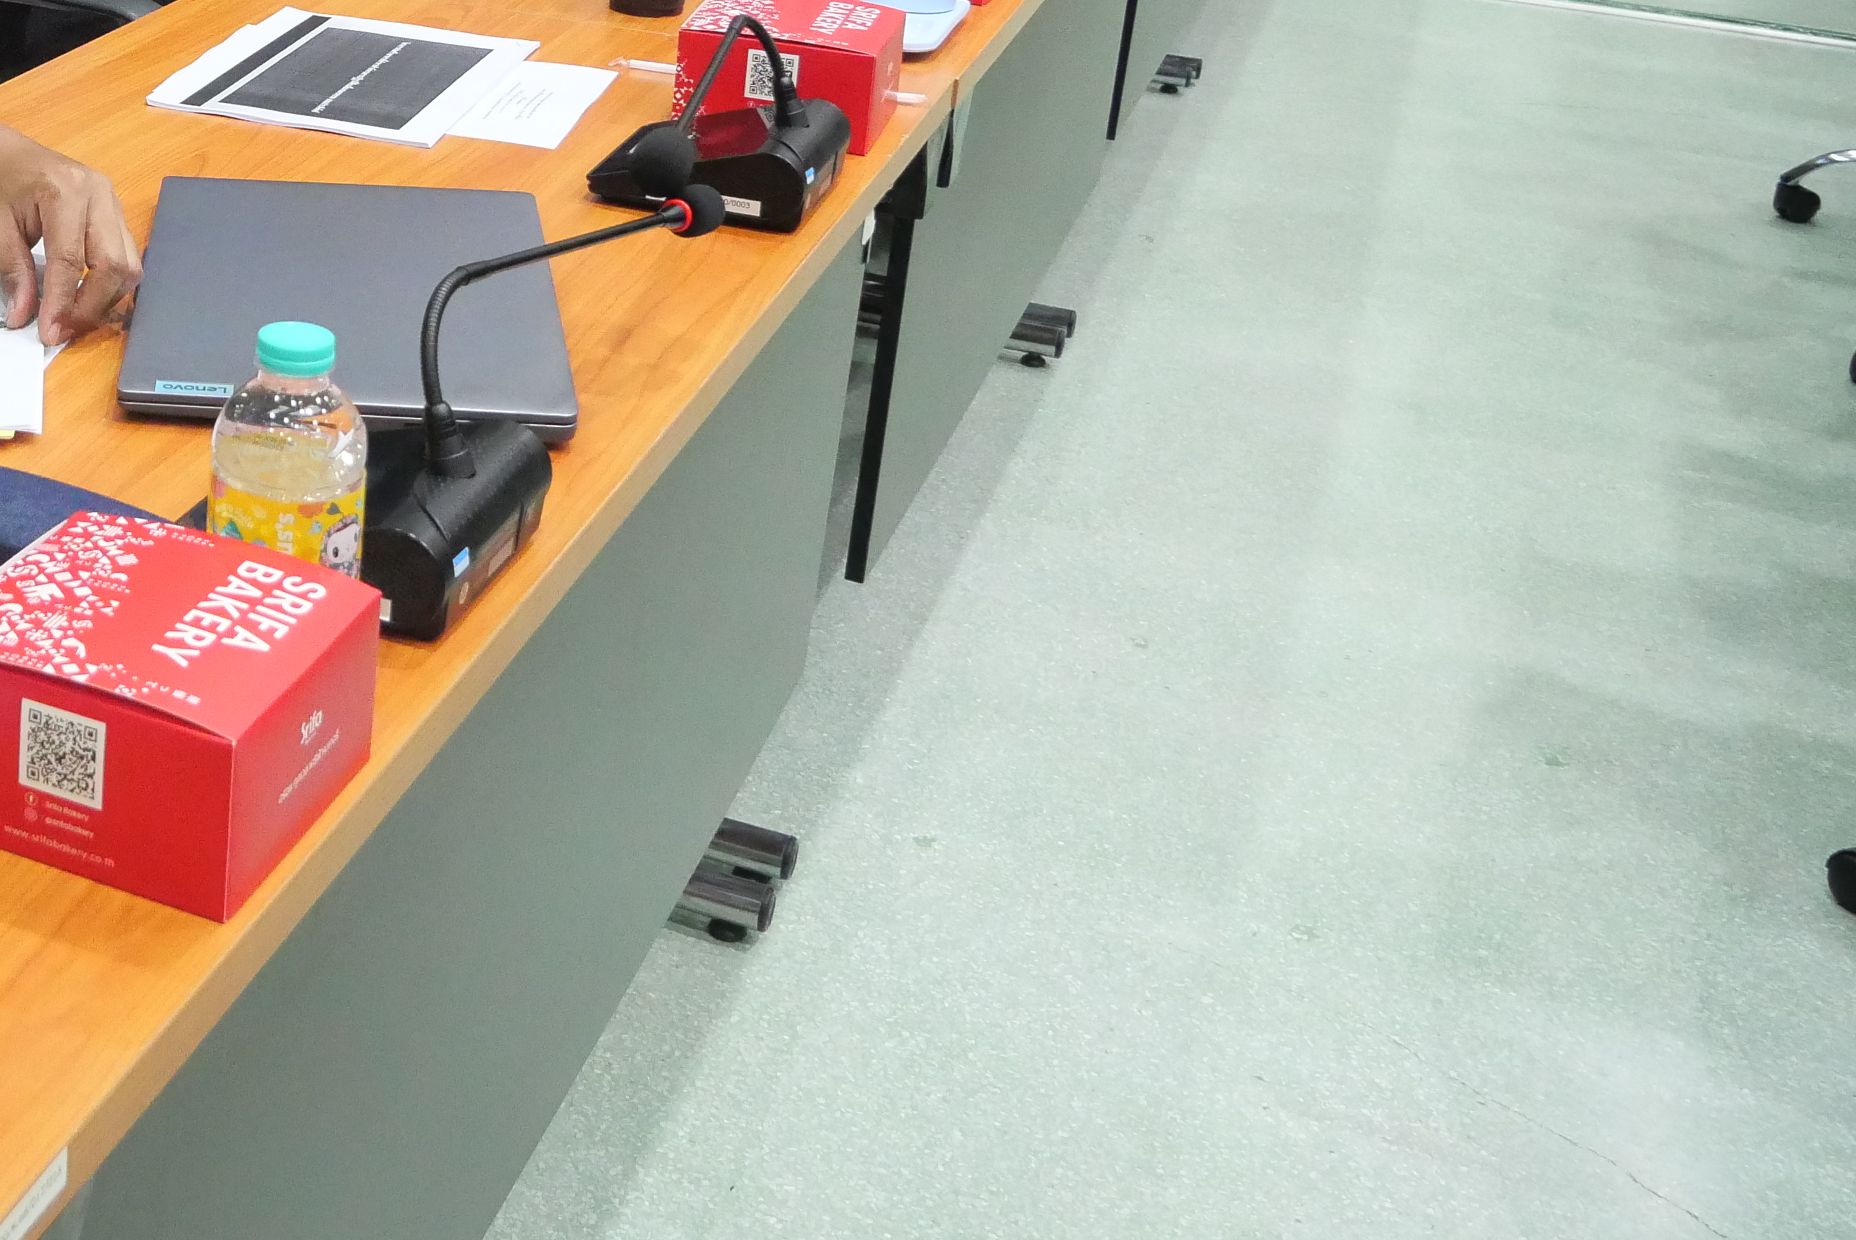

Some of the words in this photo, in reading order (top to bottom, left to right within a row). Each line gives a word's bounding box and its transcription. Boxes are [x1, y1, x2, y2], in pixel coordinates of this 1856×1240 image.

[809, 1, 854, 35] BAKERY
[842, 5, 882, 31] SRIFA
[162, 383, 227, 394] Lenovo
[151, 560, 284, 668] BAKERY
[220, 575, 327, 652] SRIFA
